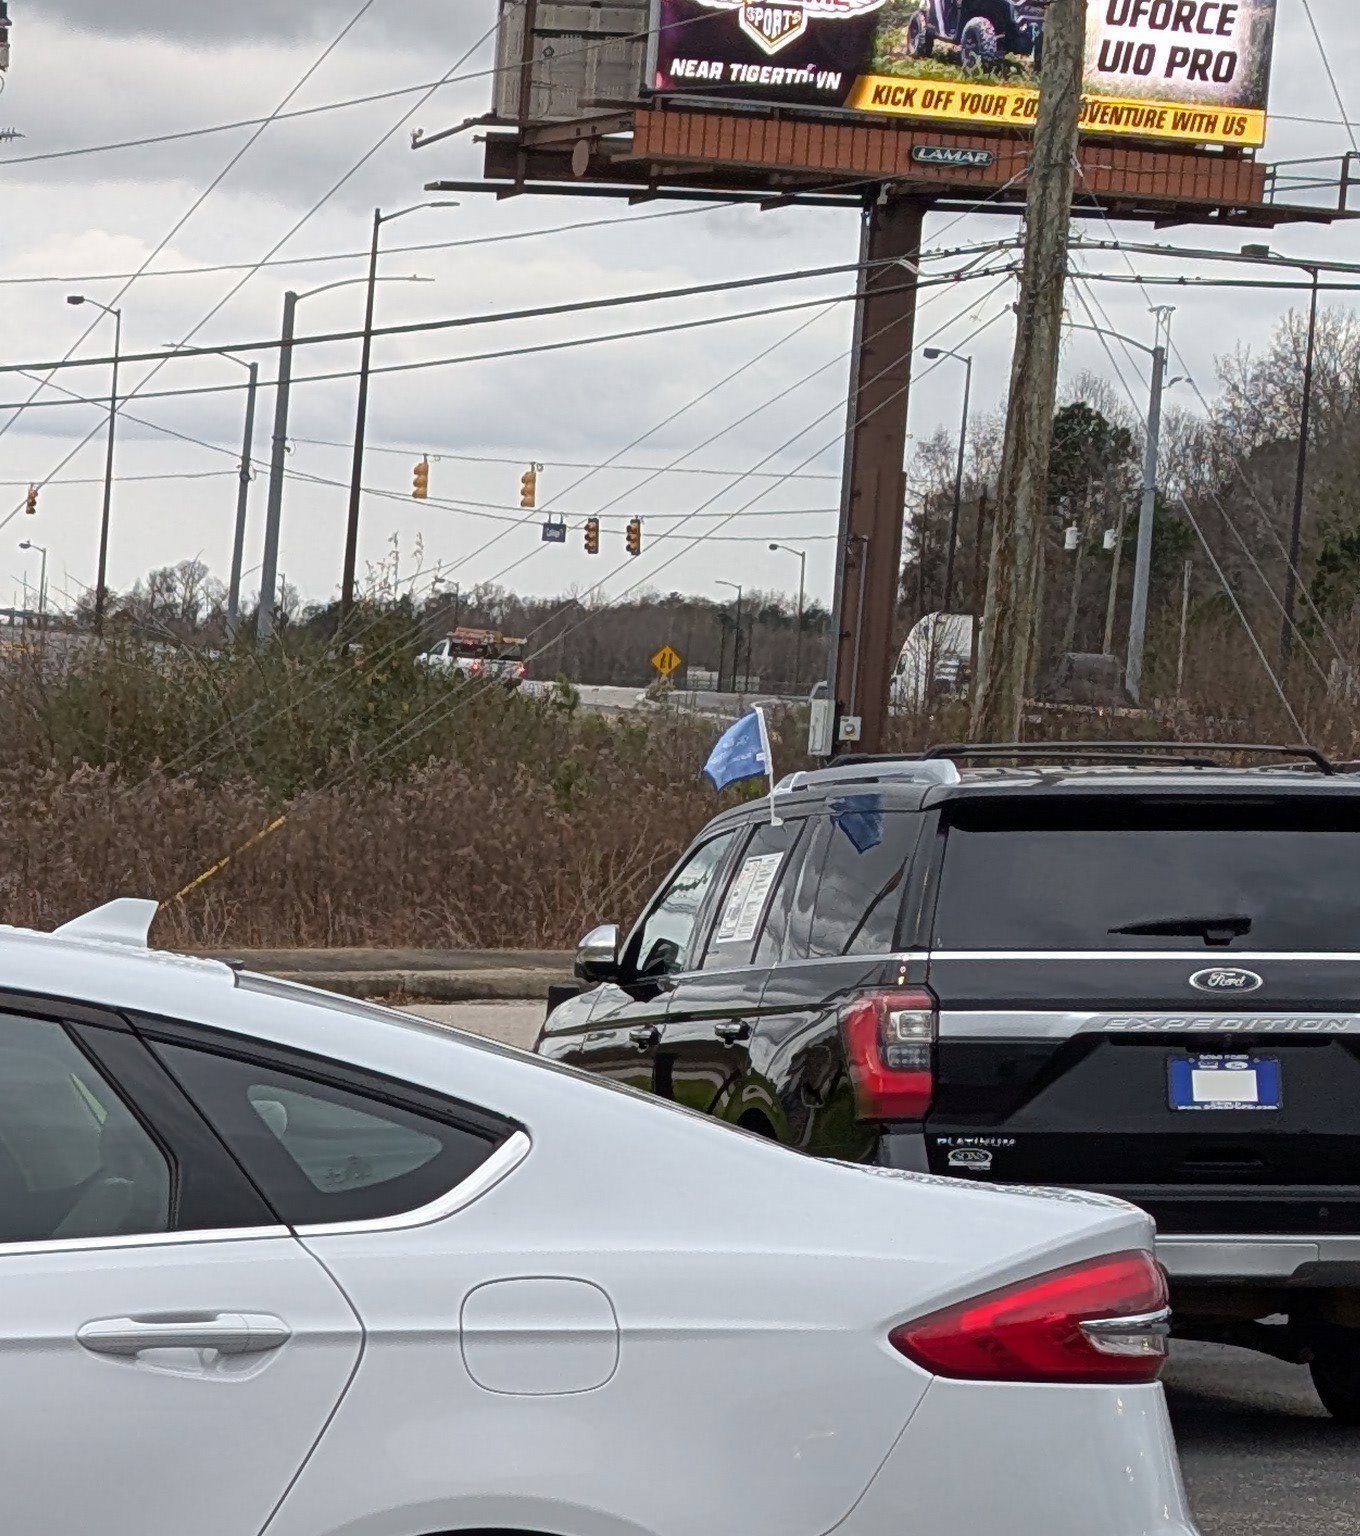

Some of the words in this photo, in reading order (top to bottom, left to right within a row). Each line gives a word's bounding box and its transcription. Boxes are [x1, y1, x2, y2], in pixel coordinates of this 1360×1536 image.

[745, 6, 803, 38] SPORTS
[1106, 0, 1238, 36] UFORCE
[670, 58, 724, 80] NEAR
[1164, 46, 1238, 83] PRO
[871, 84, 917, 108] KICK
[921, 89, 955, 112] OFF
[960, 92, 1007, 116] YOUR
[1171, 110, 1218, 134] WITH
[1222, 116, 1248, 137] US
[917, 148, 989, 163] LAMAR
[1102, 1016, 1352, 1032] EXPEDITION
